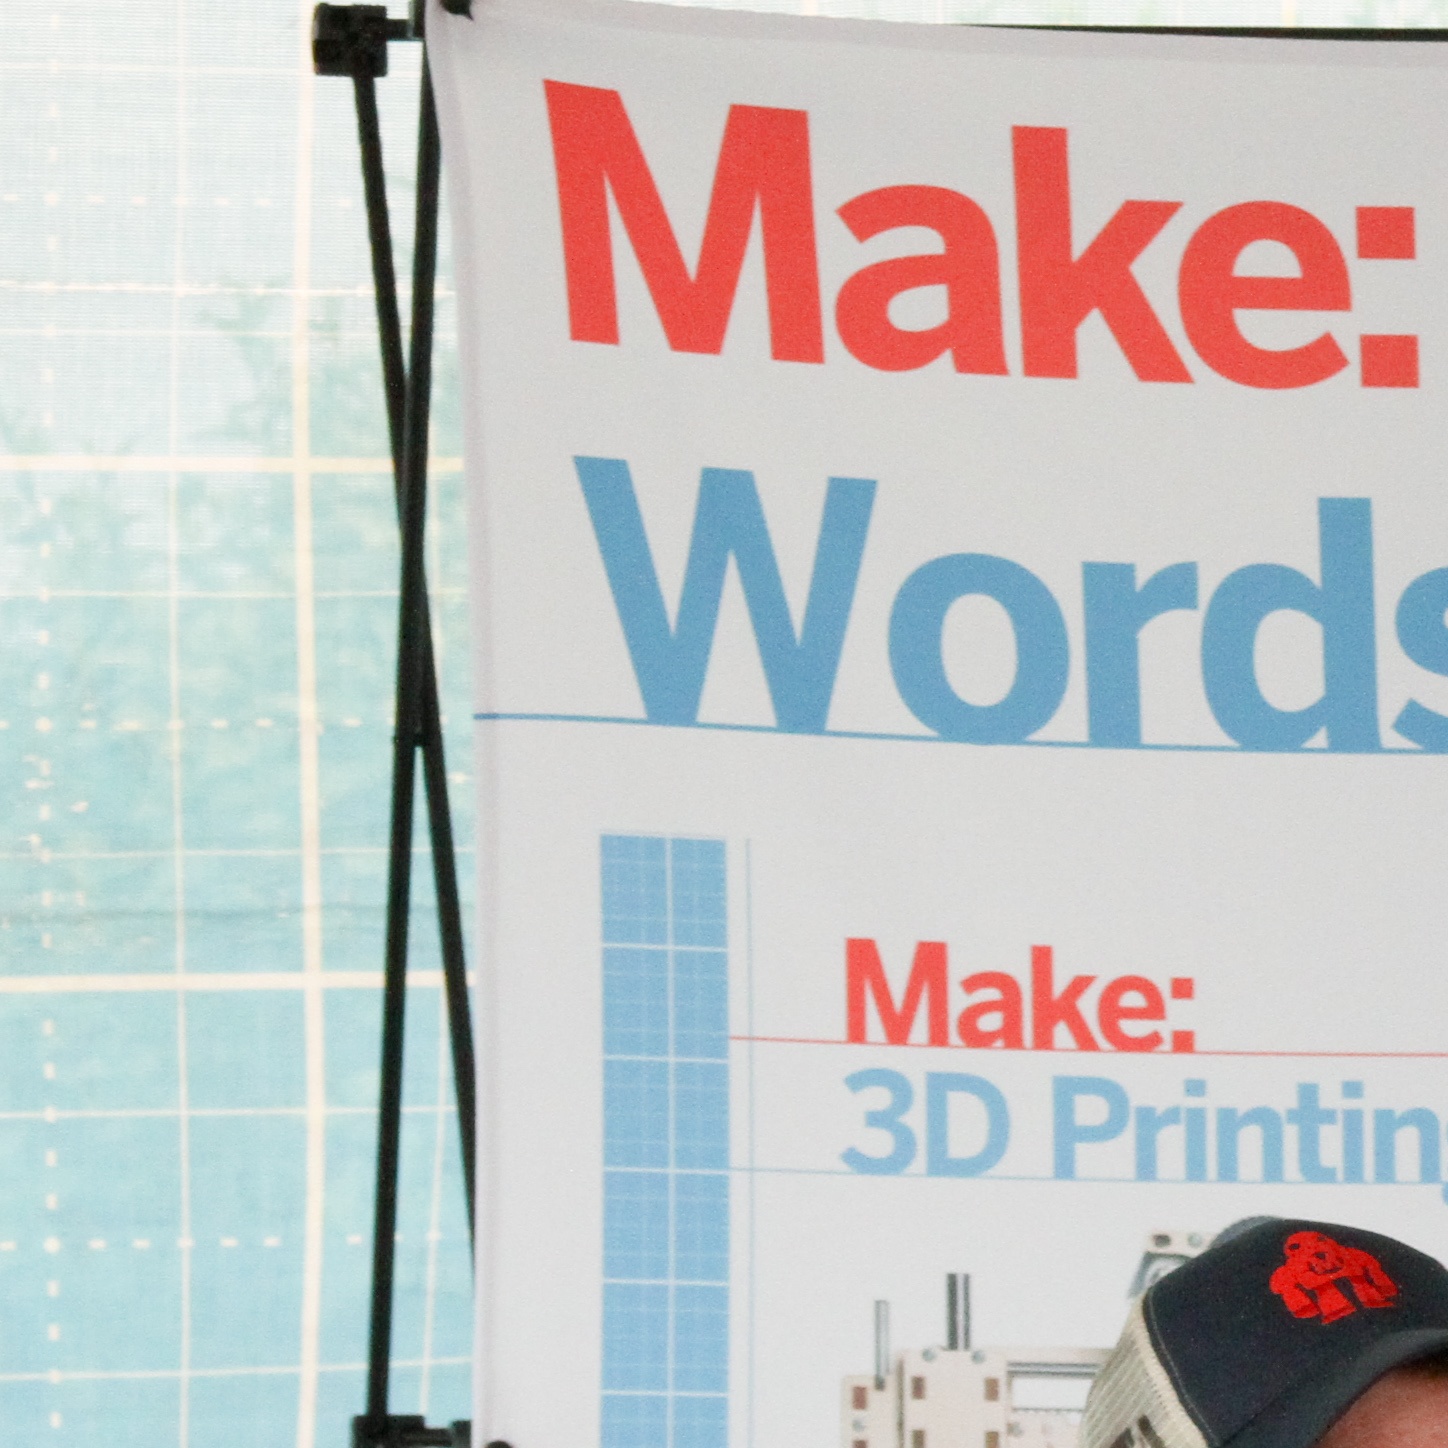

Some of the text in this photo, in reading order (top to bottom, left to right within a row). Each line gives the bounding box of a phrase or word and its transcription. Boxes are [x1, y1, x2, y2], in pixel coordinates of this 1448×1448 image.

[543, 79, 1420, 390] Make:
[844, 937, 1196, 1054] Make:
[841, 1067, 1011, 1178] 3D
